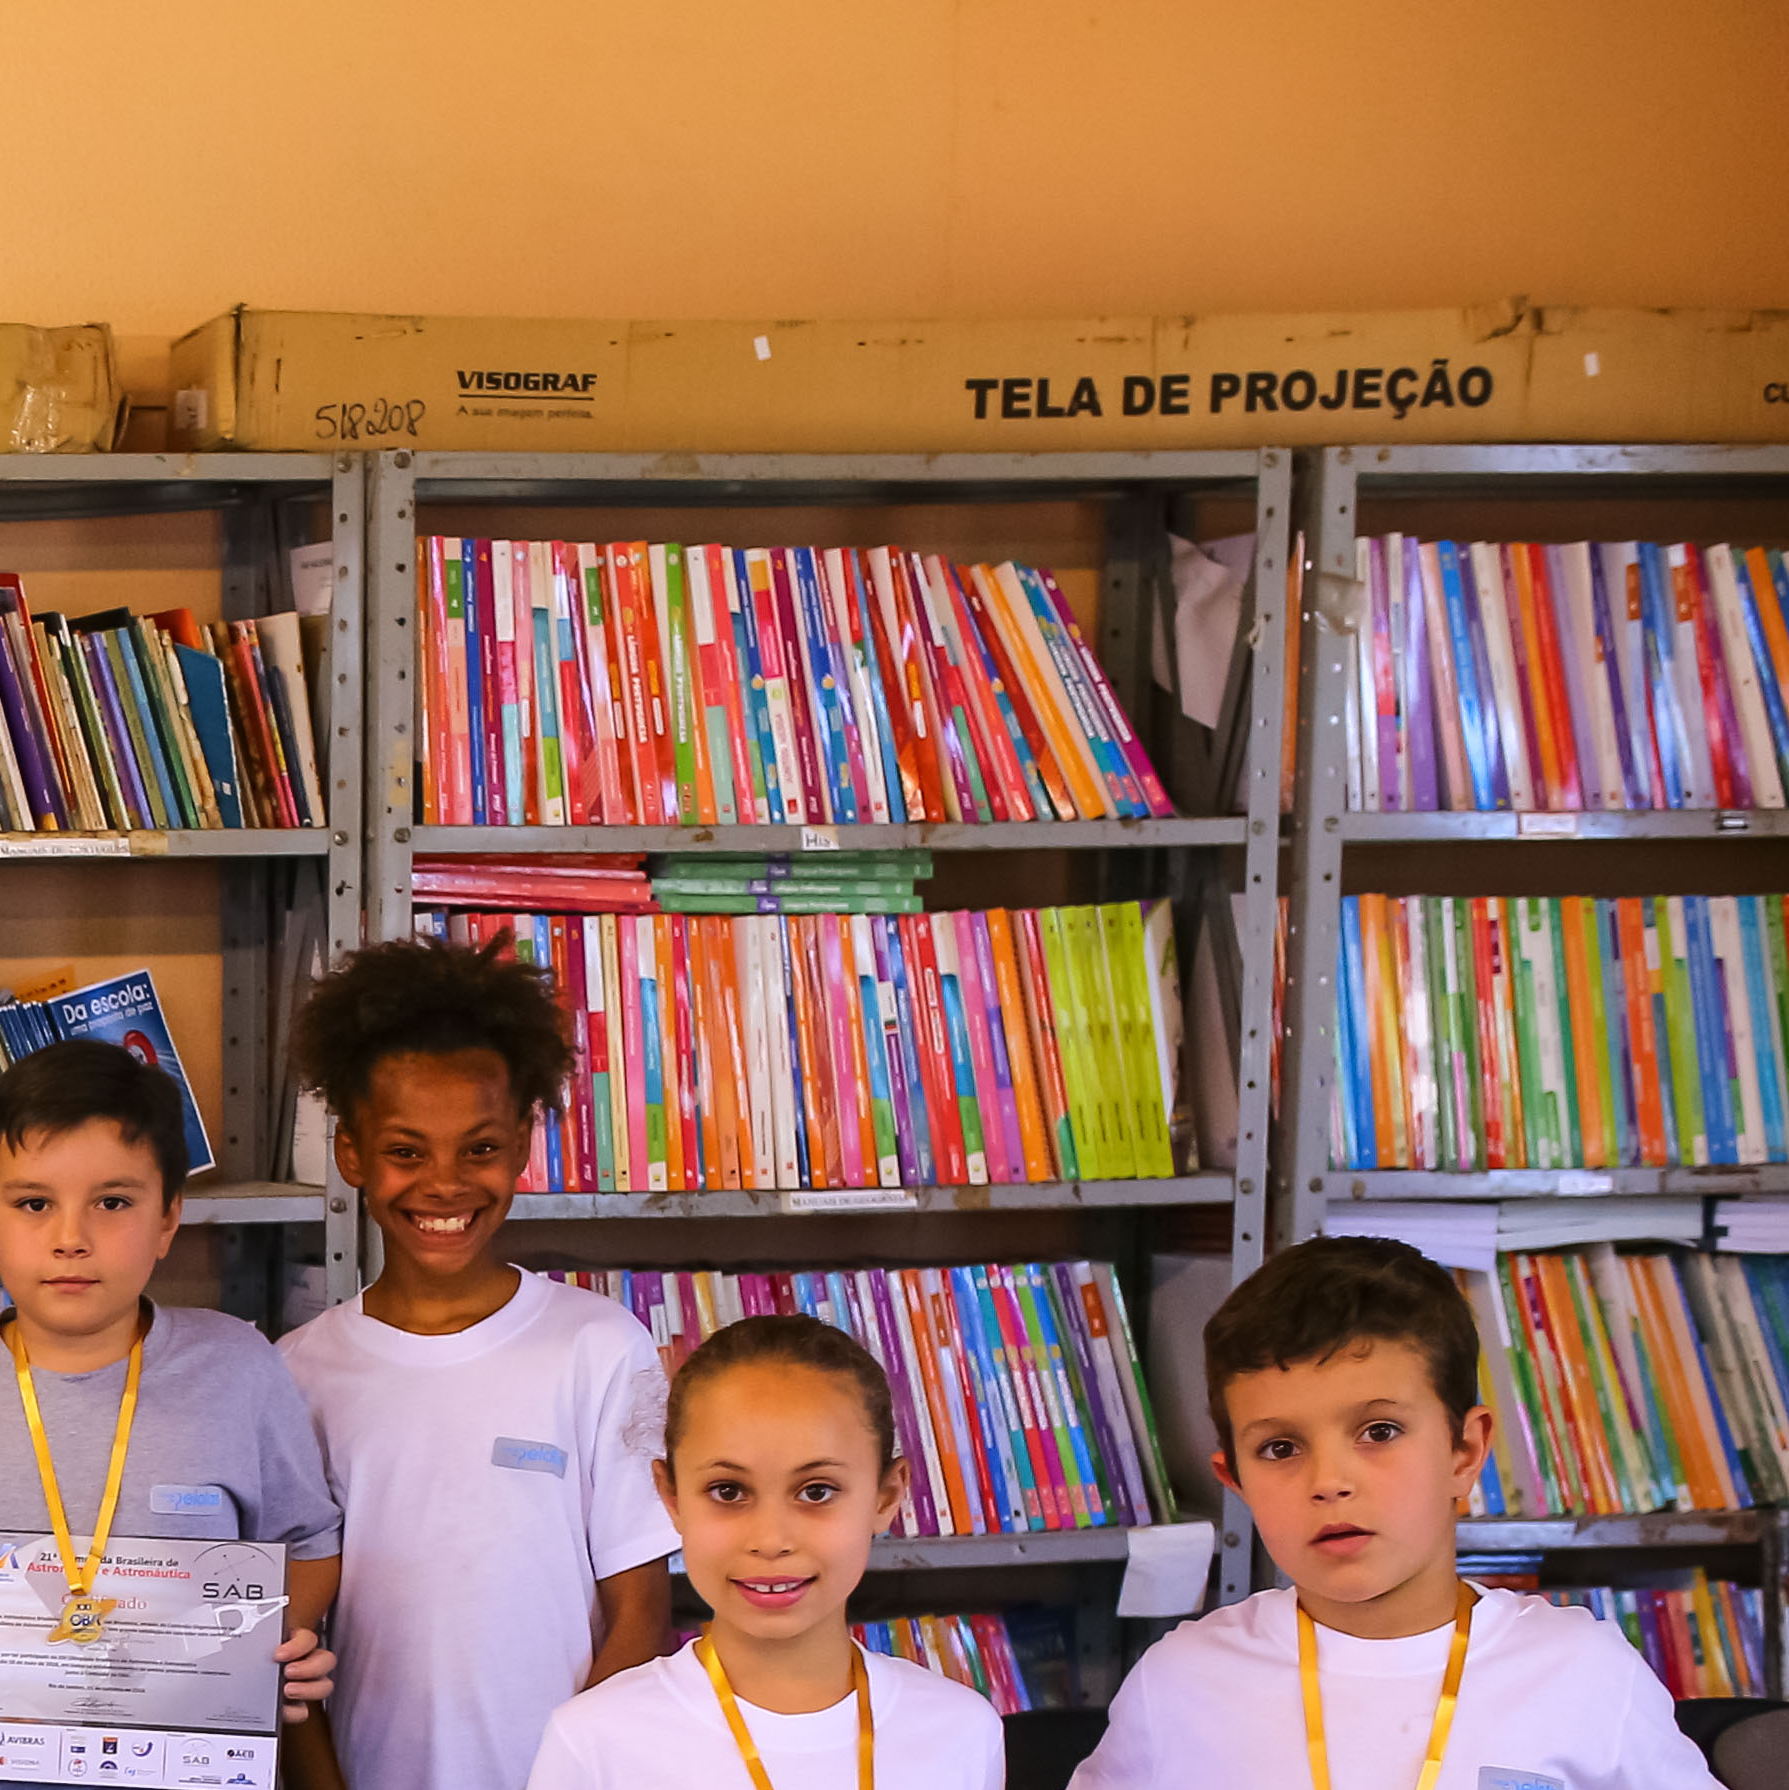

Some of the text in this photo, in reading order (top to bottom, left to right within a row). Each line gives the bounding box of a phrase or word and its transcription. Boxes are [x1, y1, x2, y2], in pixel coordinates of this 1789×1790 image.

[457, 370, 596, 393] VISOGRAF
[966, 357, 1493, 420] TELA DE PROJEÇÃO
[457, 405, 468, 417] A
[472, 408, 492, 417] sua
[496, 407, 543, 420] imagem
[63, 982, 151, 1023] Da escola:
[116, 1556, 163, 1567] Brasileira
[113, 1565, 191, 1580] Astronáutica
[202, 1583, 263, 1600] SAB
